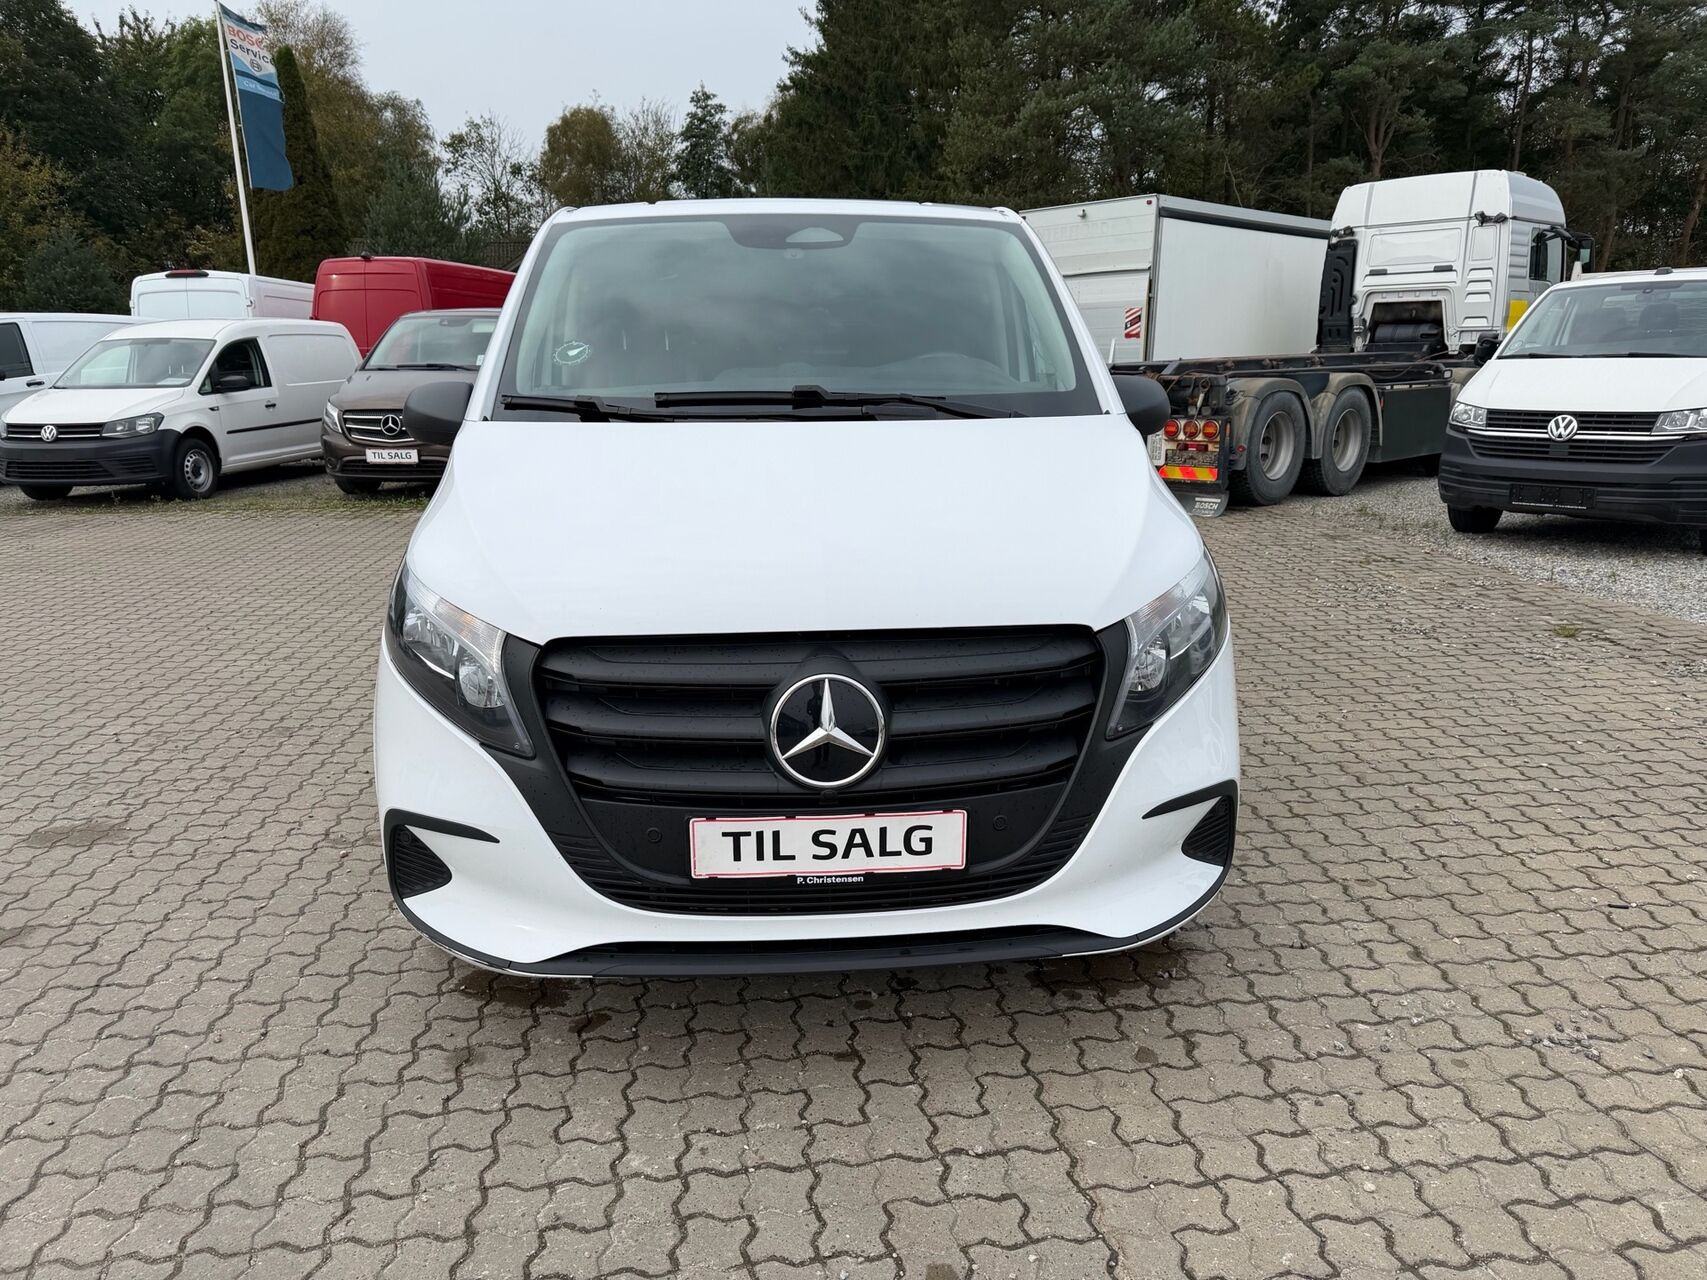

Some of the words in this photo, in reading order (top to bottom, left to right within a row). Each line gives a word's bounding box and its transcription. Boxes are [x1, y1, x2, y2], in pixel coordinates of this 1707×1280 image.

[227, 24, 265, 50] BOSC
[372, 451, 386, 460] TIL
[387, 451, 412, 460] SALG
[1194, 501, 1219, 510] BOSCH
[721, 829, 796, 862] TIL
[811, 824, 934, 860] SALG
[796, 876, 806, 885] P.
[806, 875, 864, 884] Christensen
